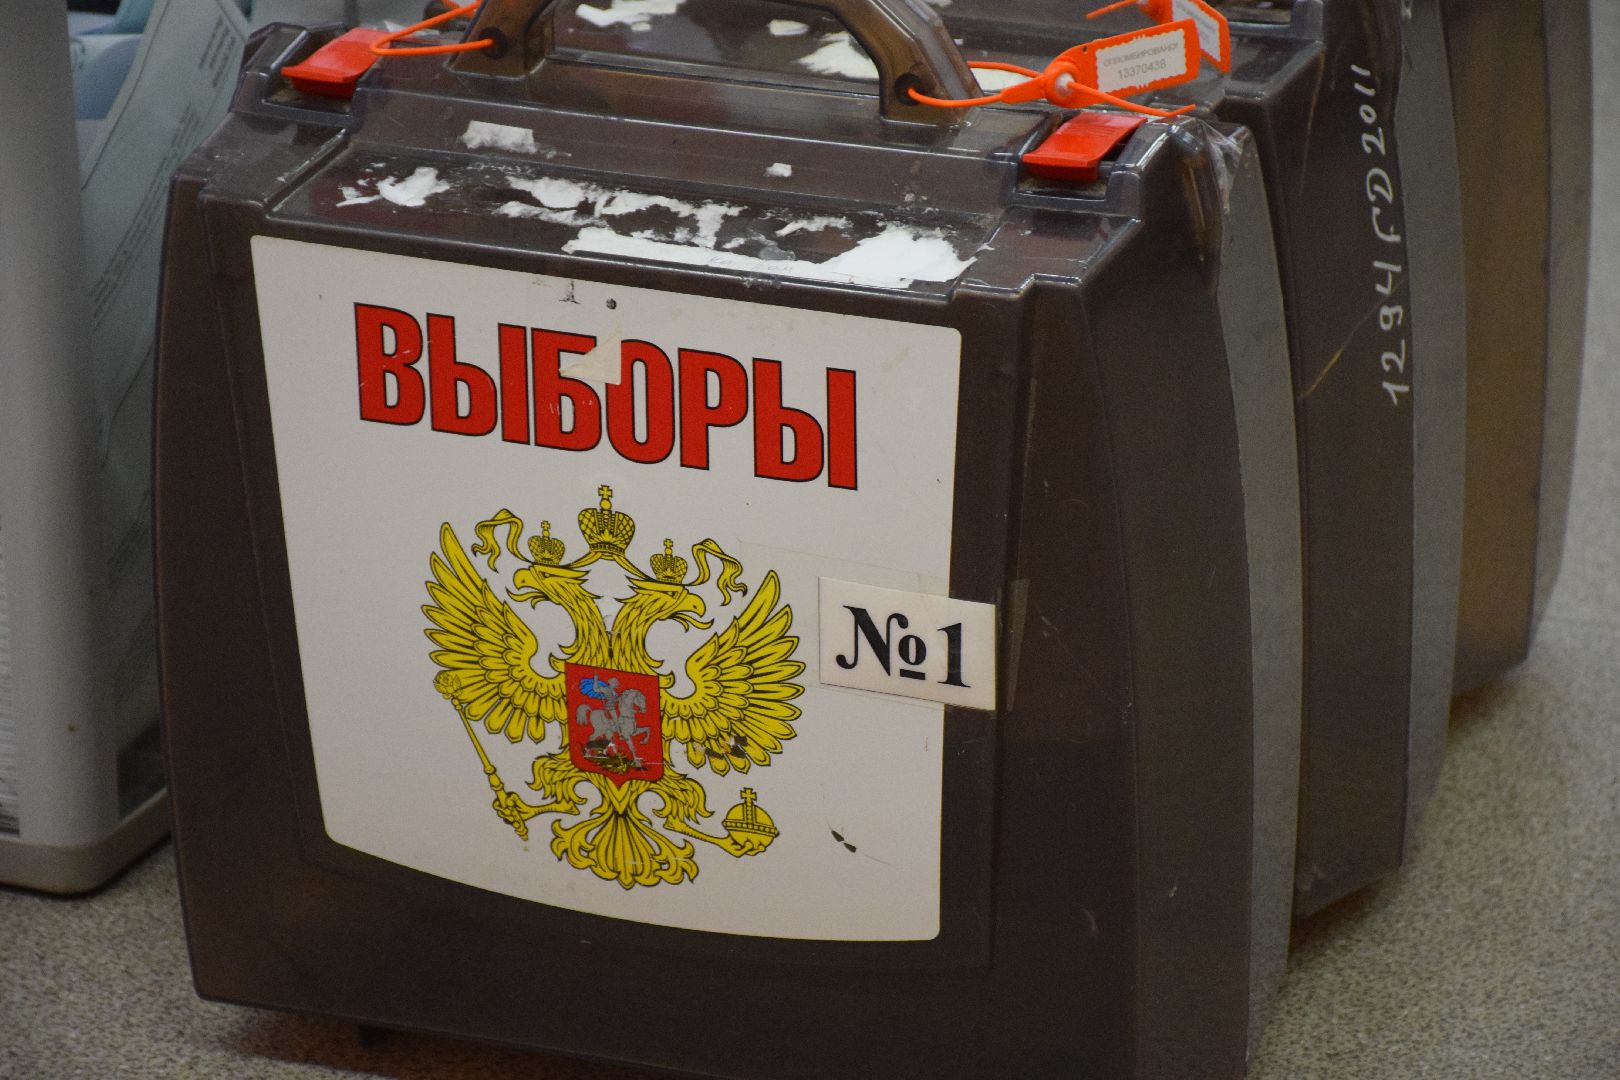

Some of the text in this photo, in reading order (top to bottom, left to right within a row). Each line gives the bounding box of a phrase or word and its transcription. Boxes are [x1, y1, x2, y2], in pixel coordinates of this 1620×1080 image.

[1117, 59, 1167, 80] 13370438
[1350, 63, 1386, 155] 2011
[354, 302, 857, 490] ВЫБОРЫ
